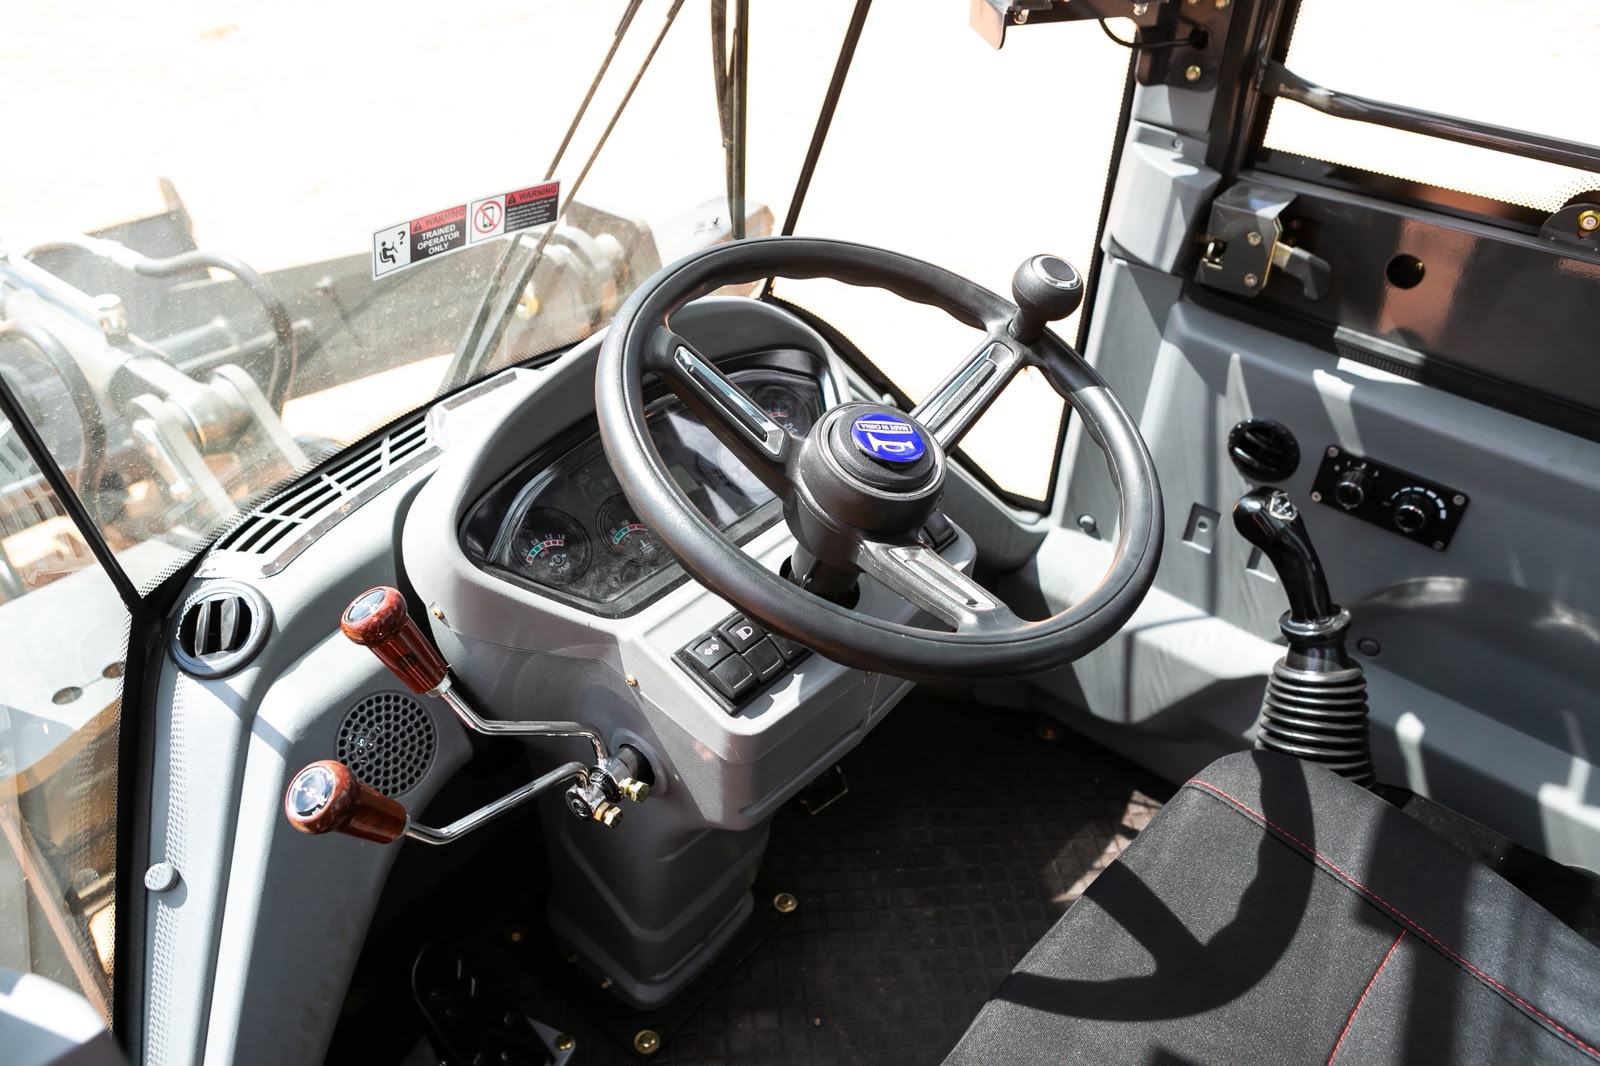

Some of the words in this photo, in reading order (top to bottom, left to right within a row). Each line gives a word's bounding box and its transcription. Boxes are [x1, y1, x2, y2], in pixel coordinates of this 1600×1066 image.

[519, 187, 557, 201] WARNING
[424, 208, 465, 227] WARNING
[421, 224, 456, 240] TRAINED
[417, 231, 460, 250] OPERATOR
[428, 244, 450, 255] ONLY
